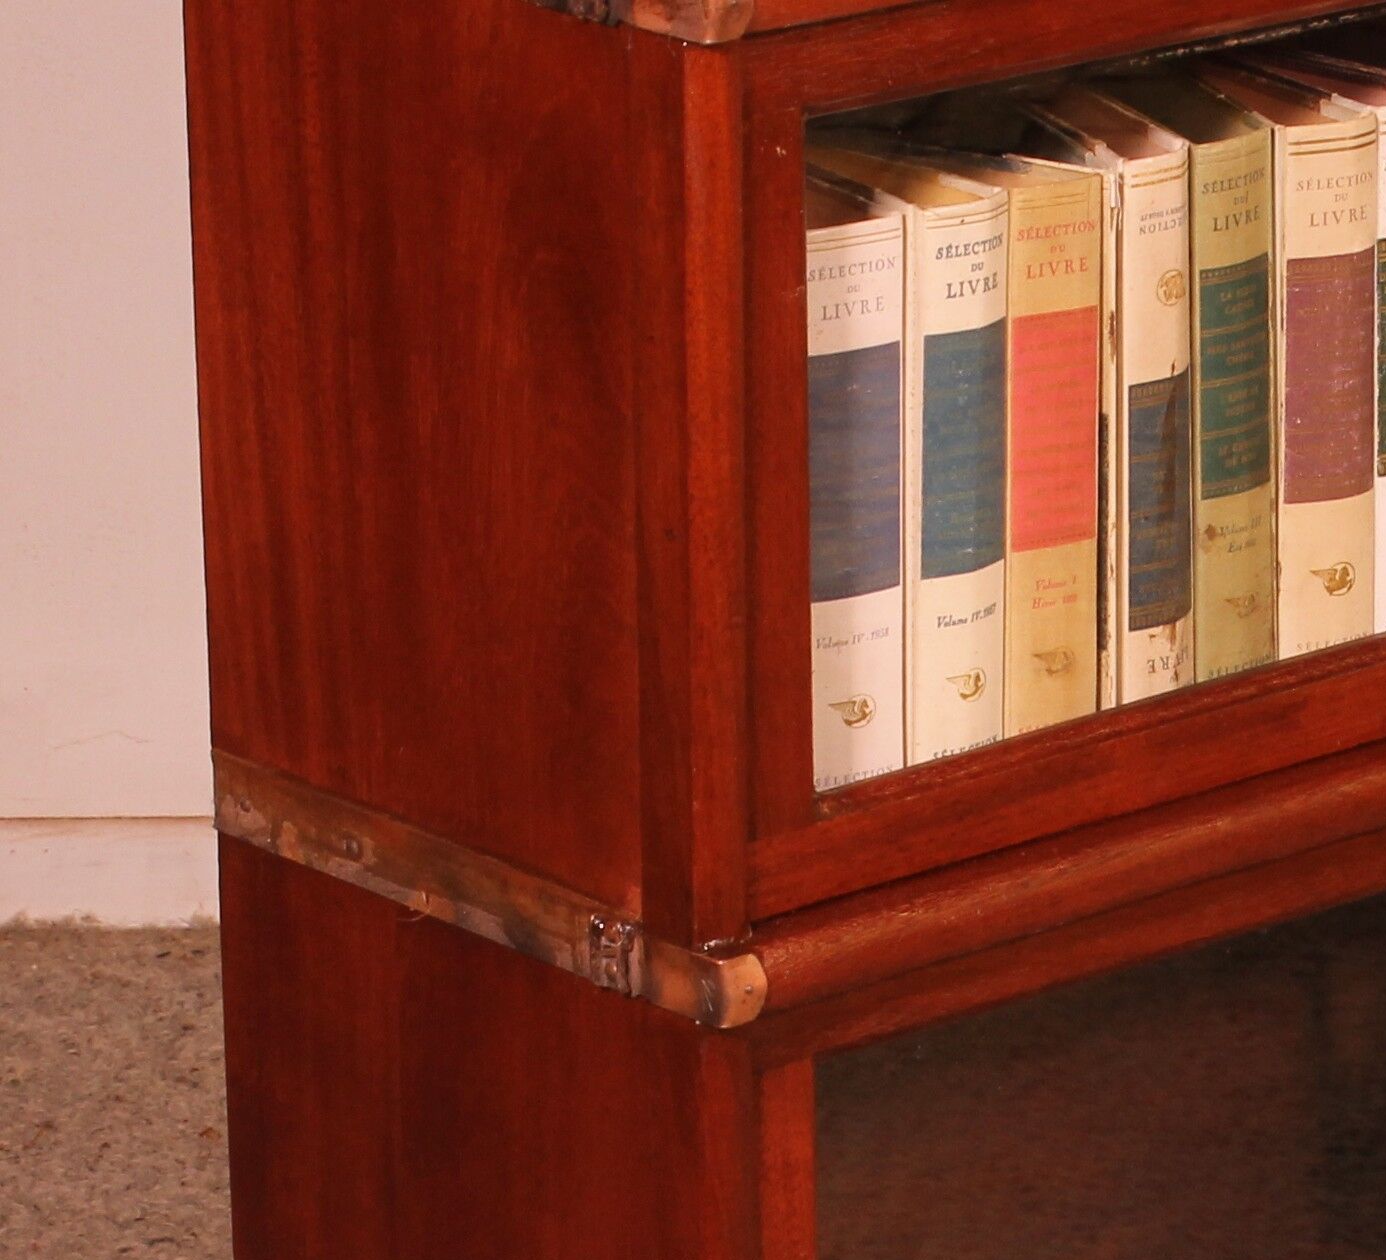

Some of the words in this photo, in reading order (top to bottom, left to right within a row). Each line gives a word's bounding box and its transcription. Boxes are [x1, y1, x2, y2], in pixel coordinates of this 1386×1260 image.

[1201, 167, 1266, 195] SÉLECTION
[1296, 171, 1374, 193] SÉLECTION
[1212, 205, 1261, 232] LIVRE
[1310, 205, 1368, 228] LIVRE
[1016, 219, 1096, 242] SÉLECTION
[935, 232, 1003, 260] SÉLECTION
[808, 256, 896, 282] SÉLECTION
[970, 261, 985, 273] DU
[1026, 256, 1089, 280] LIVRE
[945, 272, 999, 300] LIVRE
[822, 296, 885, 321] LIVRE
[937, 616, 968, 629] Volume
